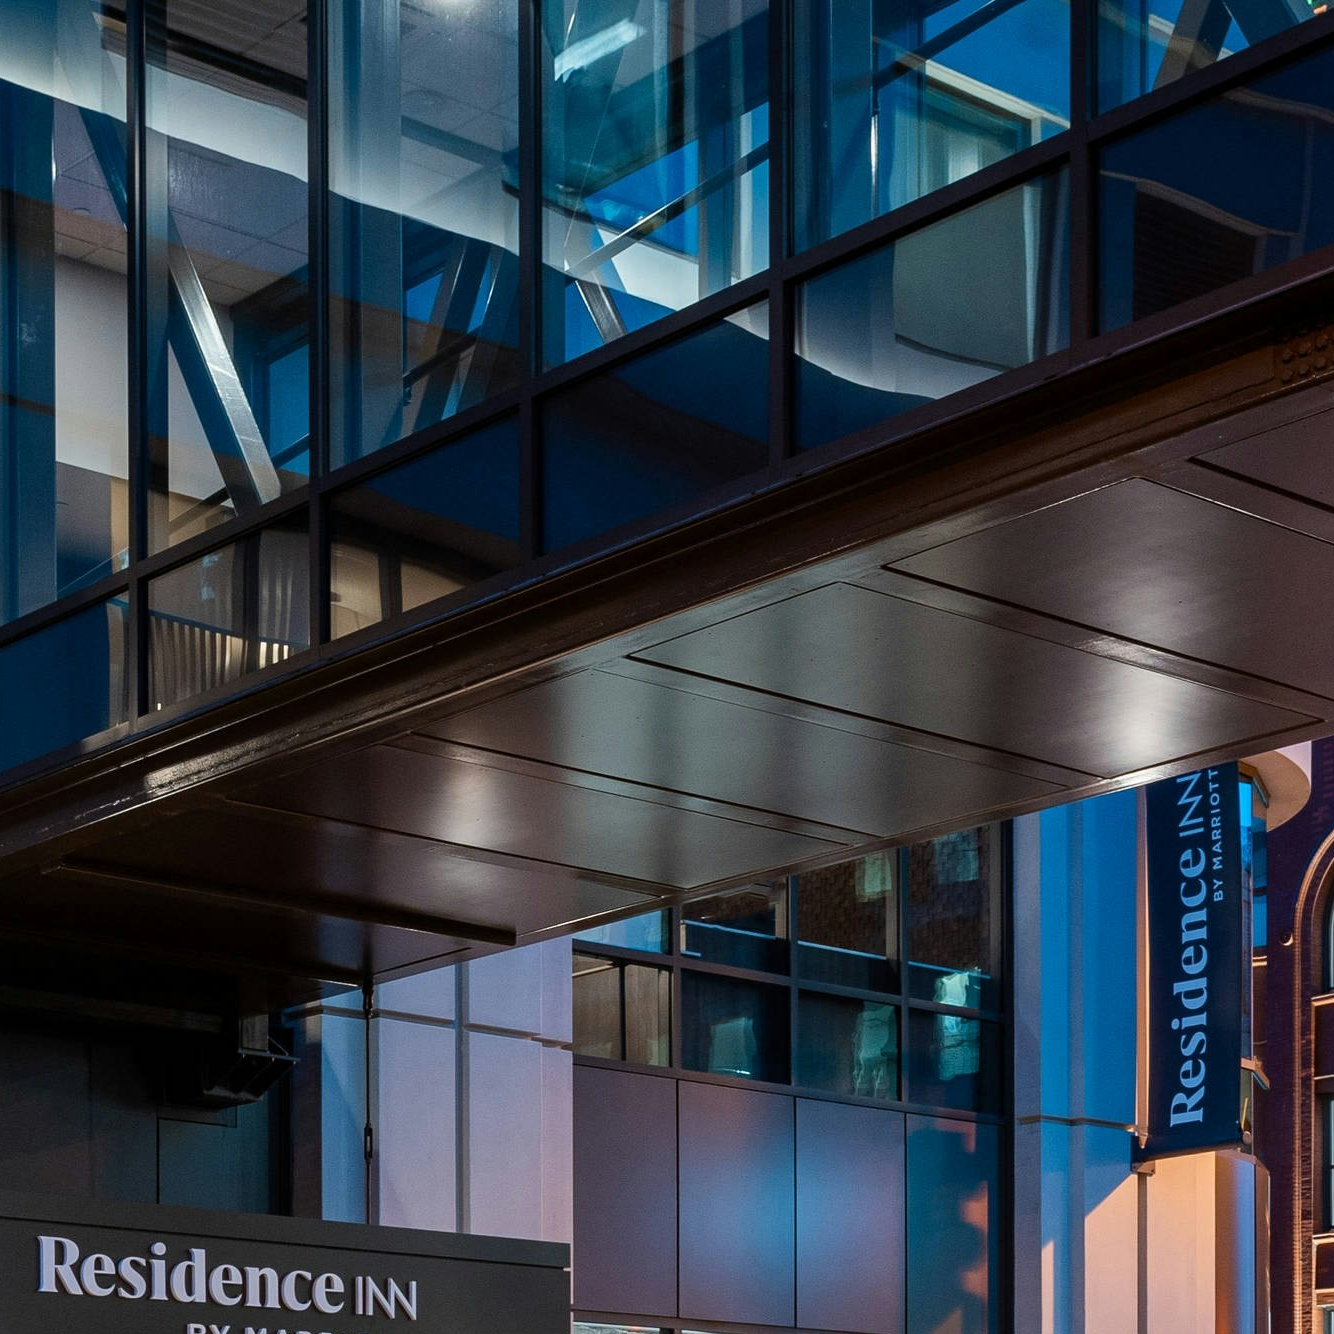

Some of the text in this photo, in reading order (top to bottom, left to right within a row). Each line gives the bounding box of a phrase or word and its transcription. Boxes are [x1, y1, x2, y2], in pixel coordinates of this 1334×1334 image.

[1208, 769, 1224, 901] BY MARRIOTT
[1170, 771, 1209, 1127] Residence INN
[37, 1235, 417, 1321] Residence INN
